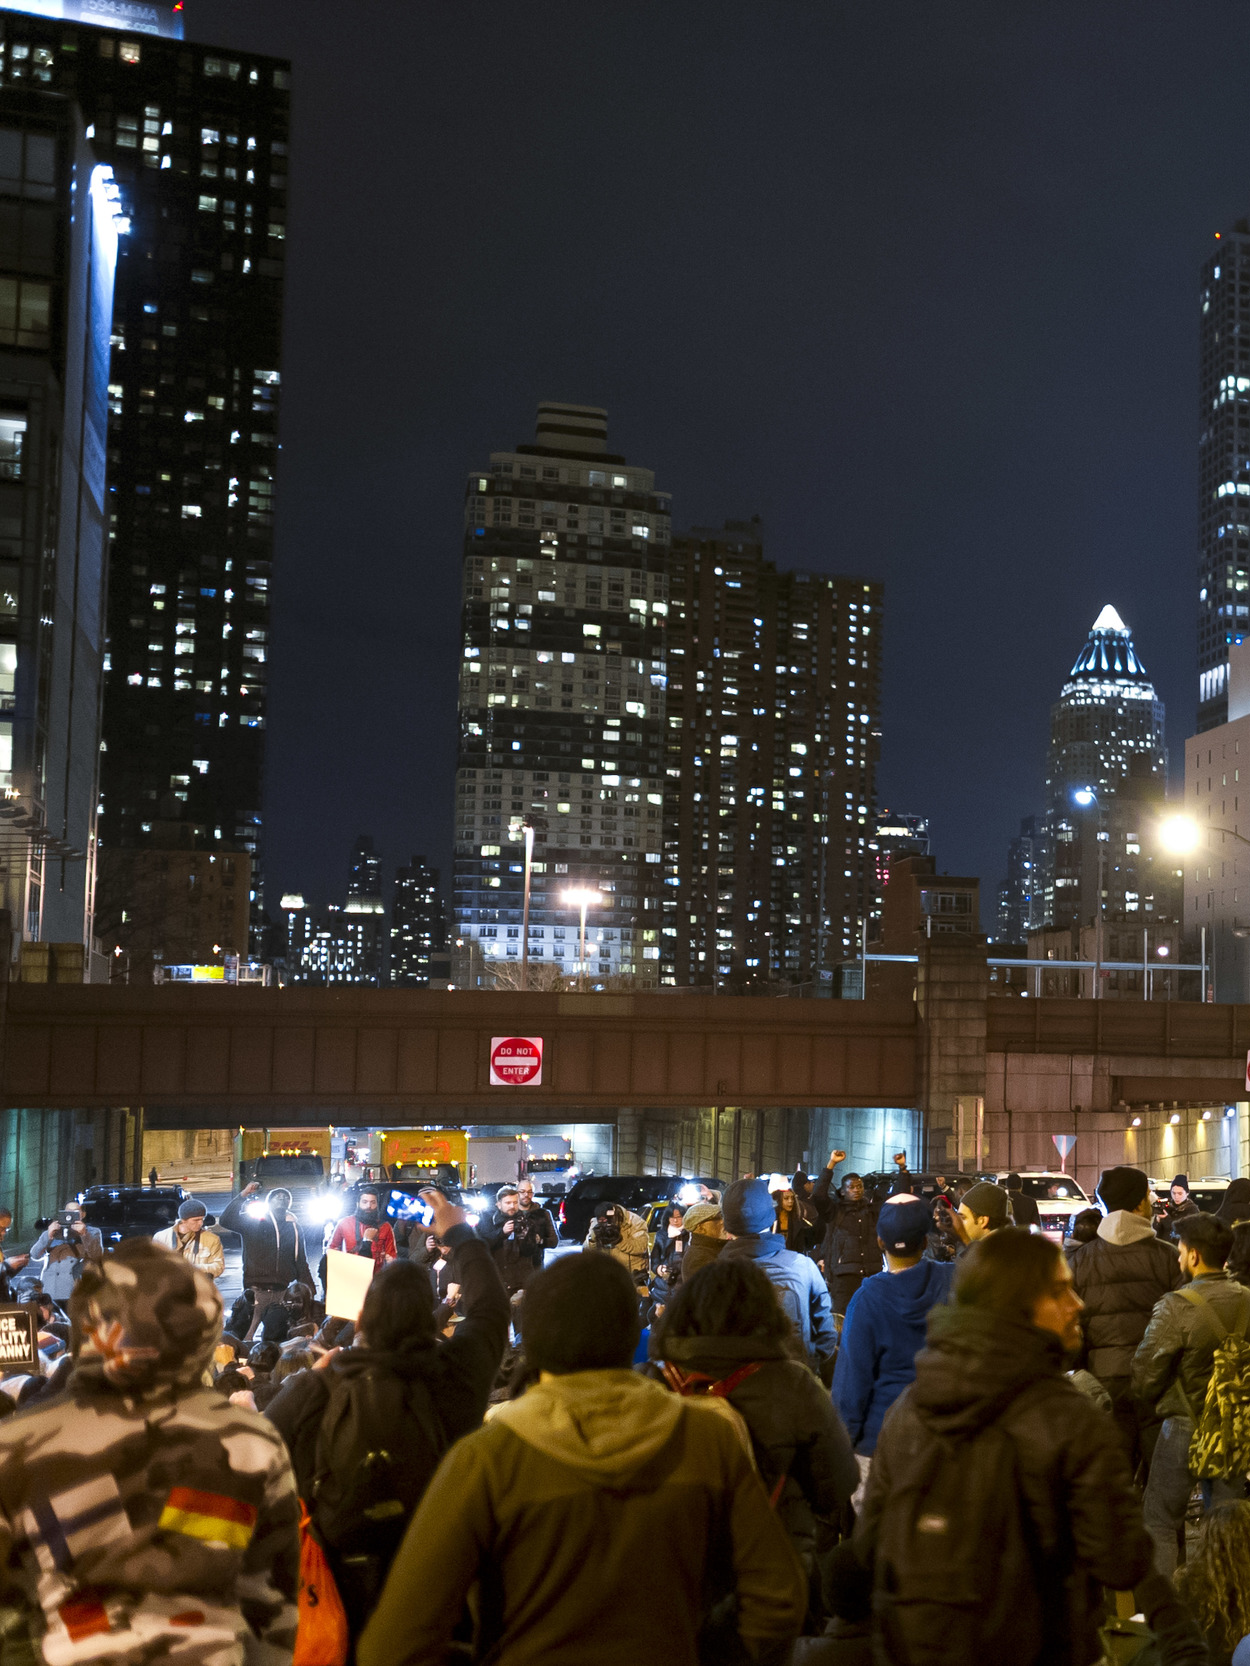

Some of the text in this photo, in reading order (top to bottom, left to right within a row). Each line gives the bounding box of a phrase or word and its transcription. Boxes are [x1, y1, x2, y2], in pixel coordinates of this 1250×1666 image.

[503, 1067, 530, 1075] ENTER
[269, 1141, 310, 1151] DHL
[0, 1318, 16, 1331] CE
